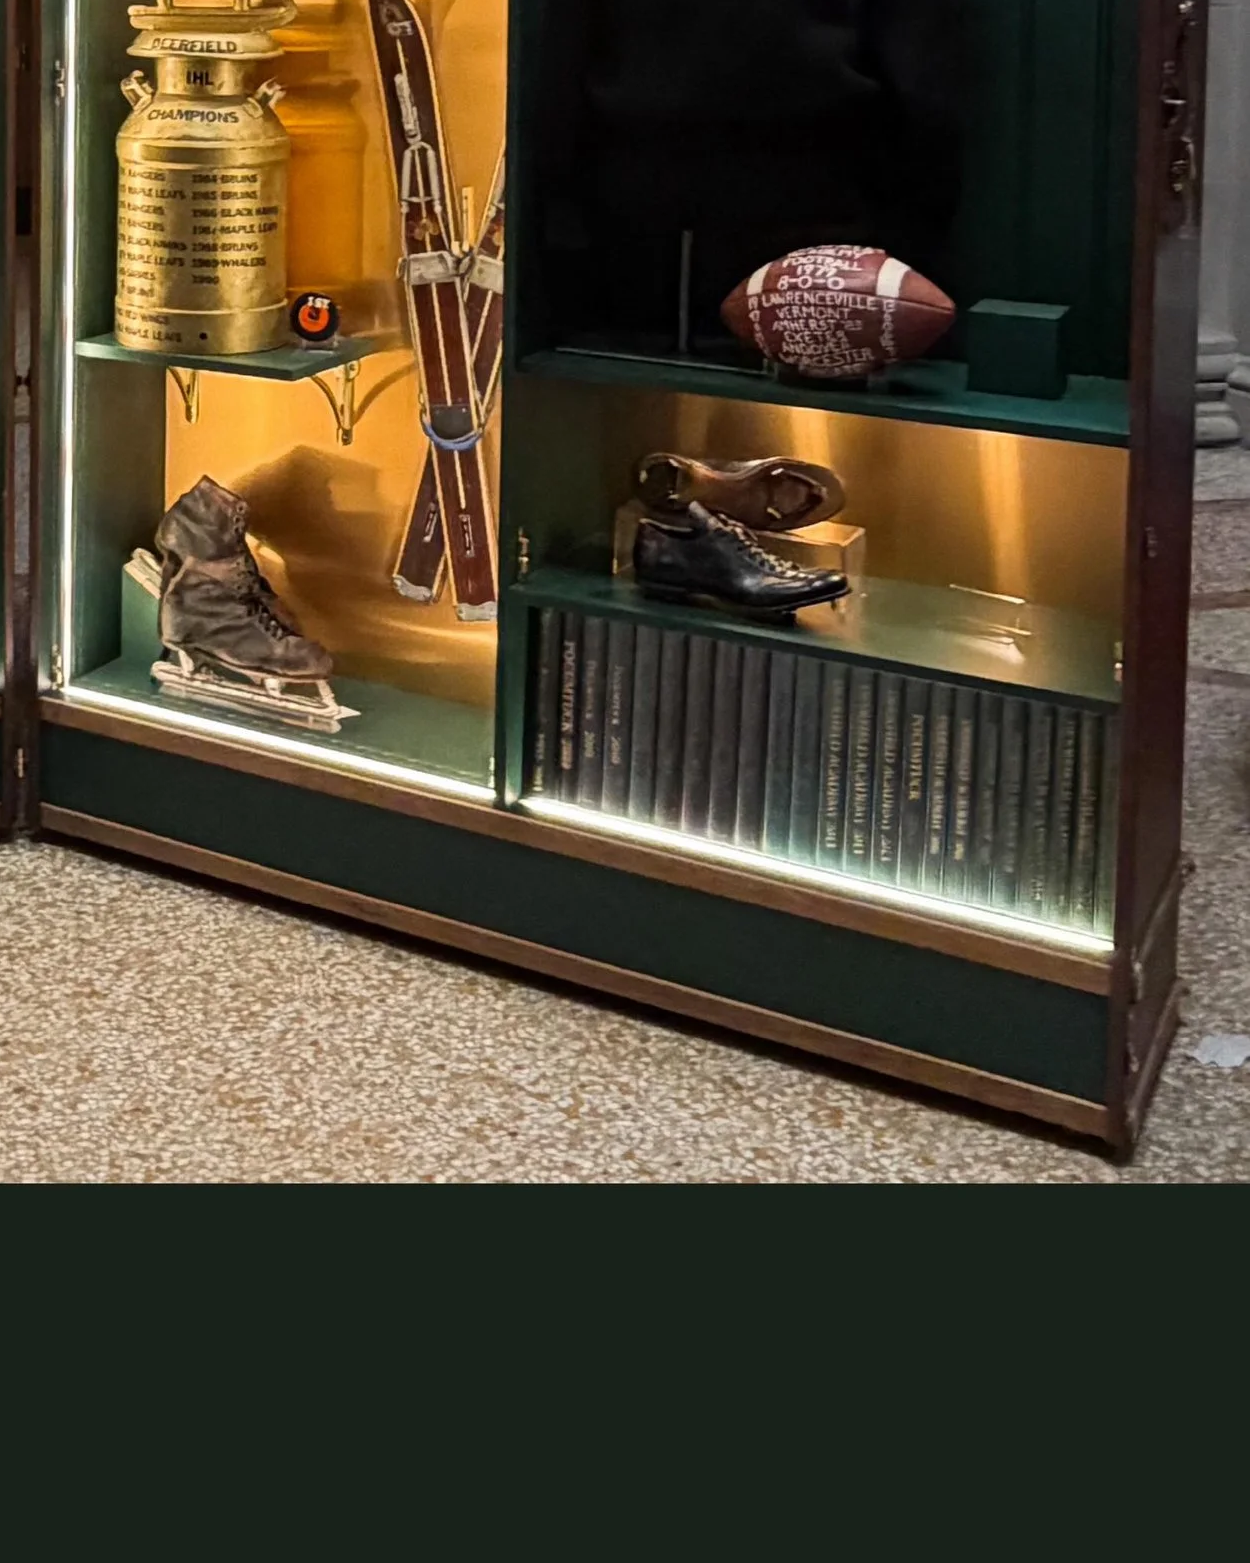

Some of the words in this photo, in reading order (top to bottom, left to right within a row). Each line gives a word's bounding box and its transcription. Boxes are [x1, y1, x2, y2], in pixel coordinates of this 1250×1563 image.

[152, 37, 238, 54] DEERFIELD
[186, 70, 215, 87] IHL
[147, 108, 240, 124] CHAMPIONS
[782, 256, 864, 272] FOOTBALL
[762, 290, 878, 311] LAWRENCEVILLE
[776, 306, 850, 320] VERMONT
[772, 319, 837, 331] AMHERST
[562, 641, 577, 735] POCUMTUCK
